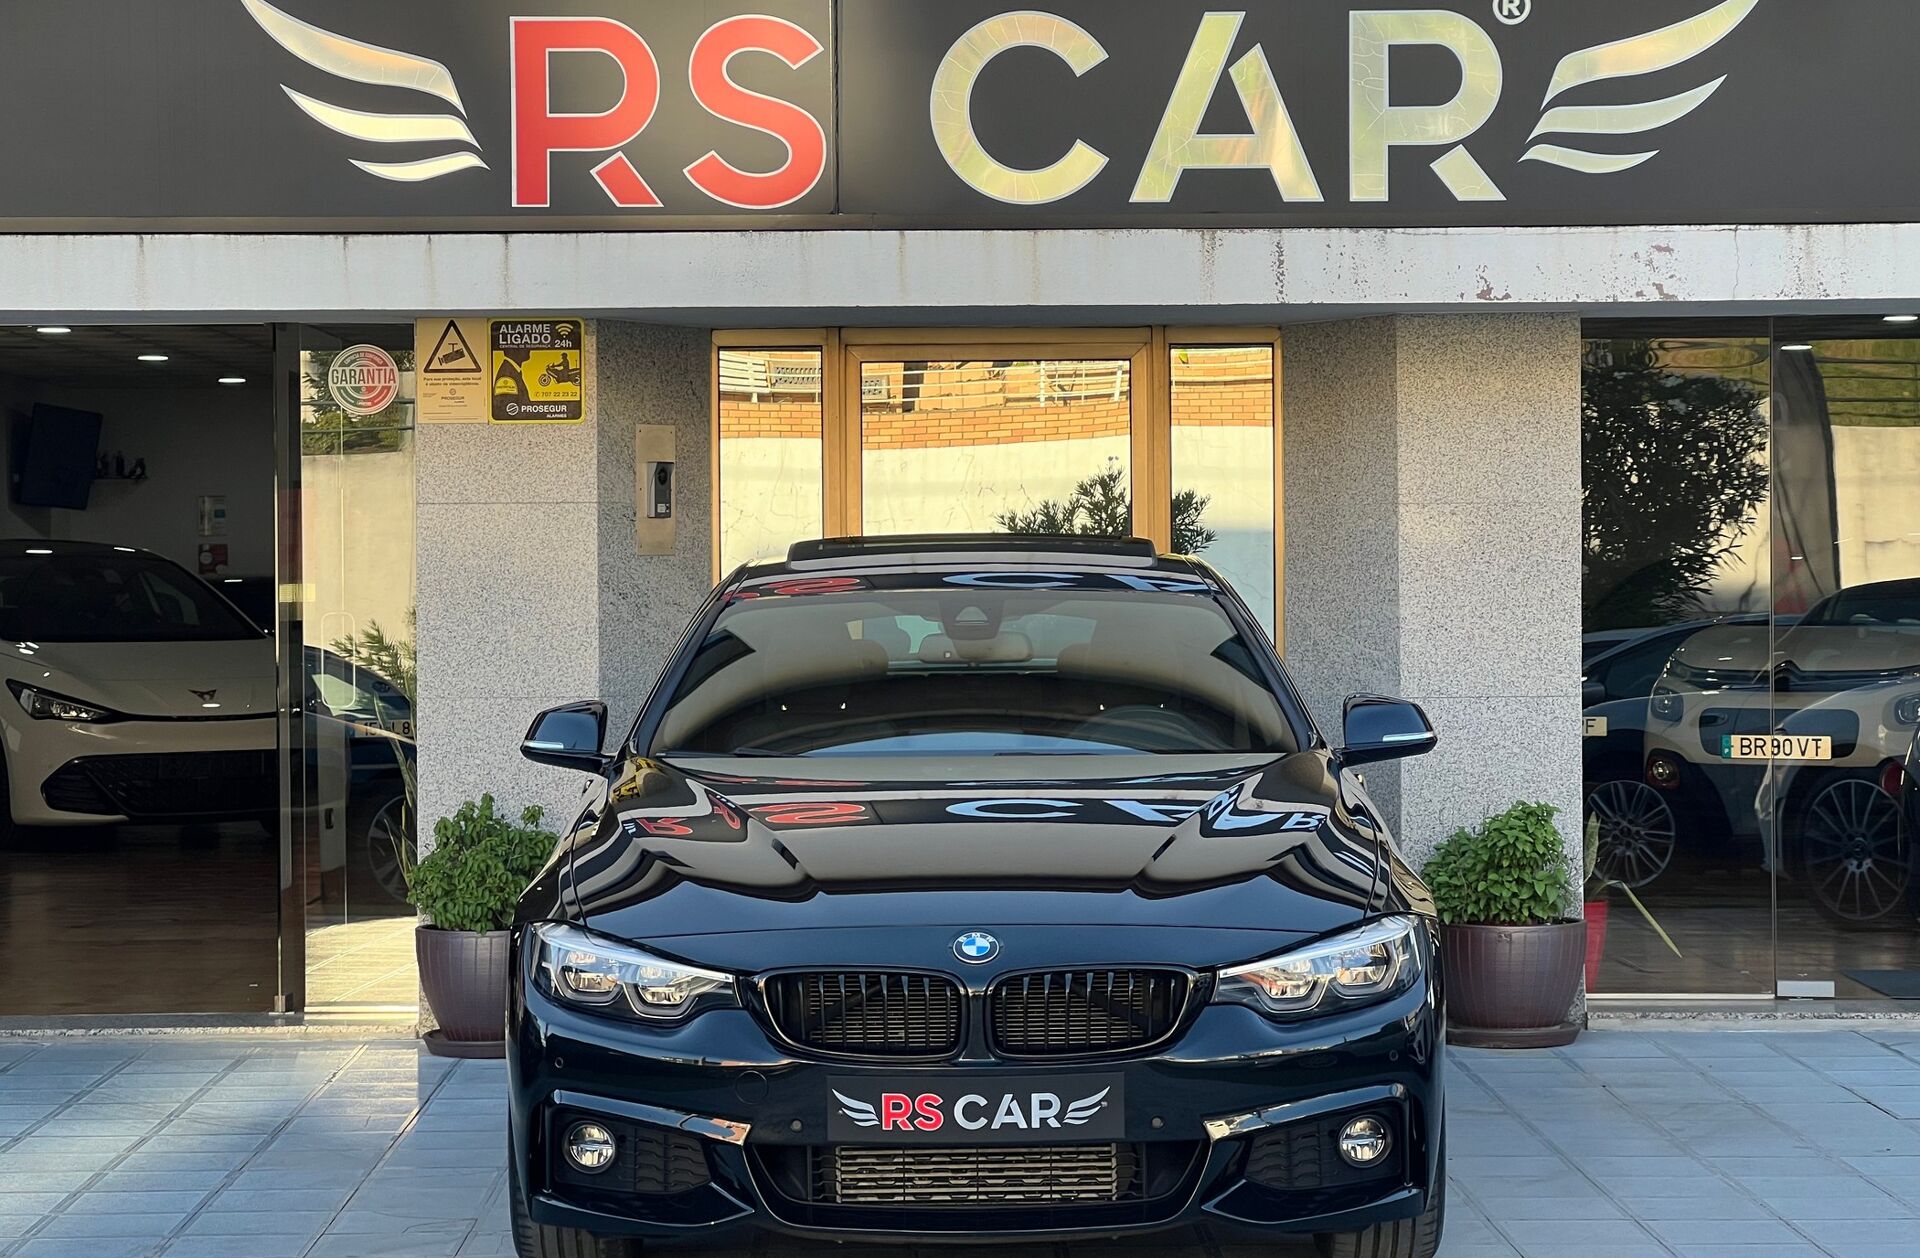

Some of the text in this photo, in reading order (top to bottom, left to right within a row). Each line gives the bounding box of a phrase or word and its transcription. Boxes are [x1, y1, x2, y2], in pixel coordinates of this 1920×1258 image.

[509, 14, 826, 209] RS
[930, 10, 1507, 205] CAR
[499, 323, 551, 333] ALARME
[499, 333, 552, 344] LIGADO
[554, 339, 572, 348] 24h
[331, 368, 396, 385] GARANTIA
[521, 405, 567, 413] PROSEGUR
[881, 1093, 1062, 1131] RS CAR
